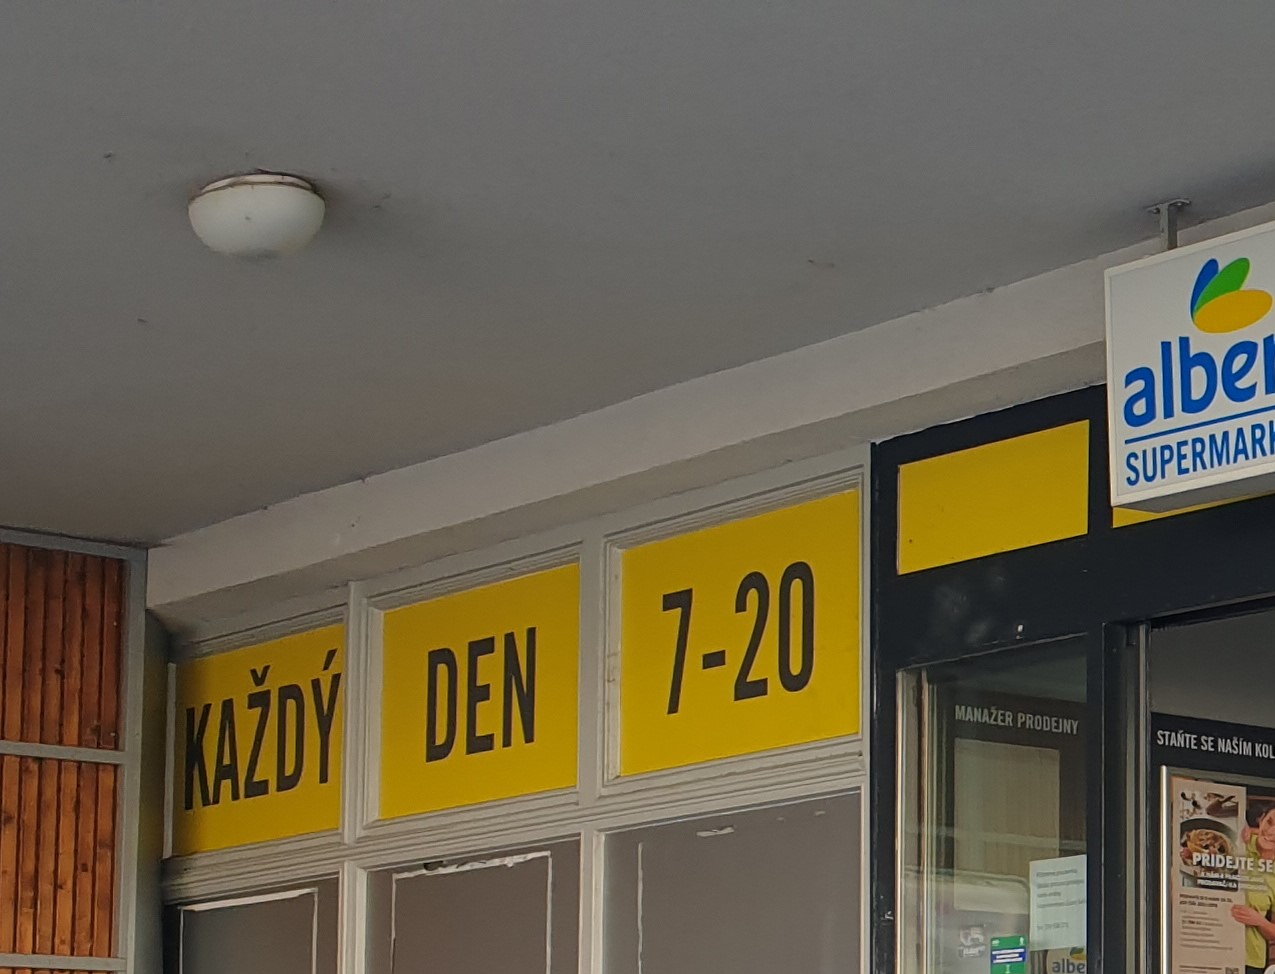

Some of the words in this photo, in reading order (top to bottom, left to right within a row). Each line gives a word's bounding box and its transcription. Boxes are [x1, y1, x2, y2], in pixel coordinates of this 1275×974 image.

[182, 649, 343, 812] KAŽDÝ
[424, 626, 538, 764] DEN
[661, 560, 816, 716] 7-20
[954, 704, 1014, 728] MANAŽER
[1017, 712, 1080, 735] PRODEJNY
[1156, 729, 1198, 750] STAŇTE
[1200, 735, 1215, 752] SE
[1217, 736, 1252, 757] NAŠÍM
[1192, 849, 1255, 871] PŘIDEJTE
[1257, 859, 1274, 873] SE
